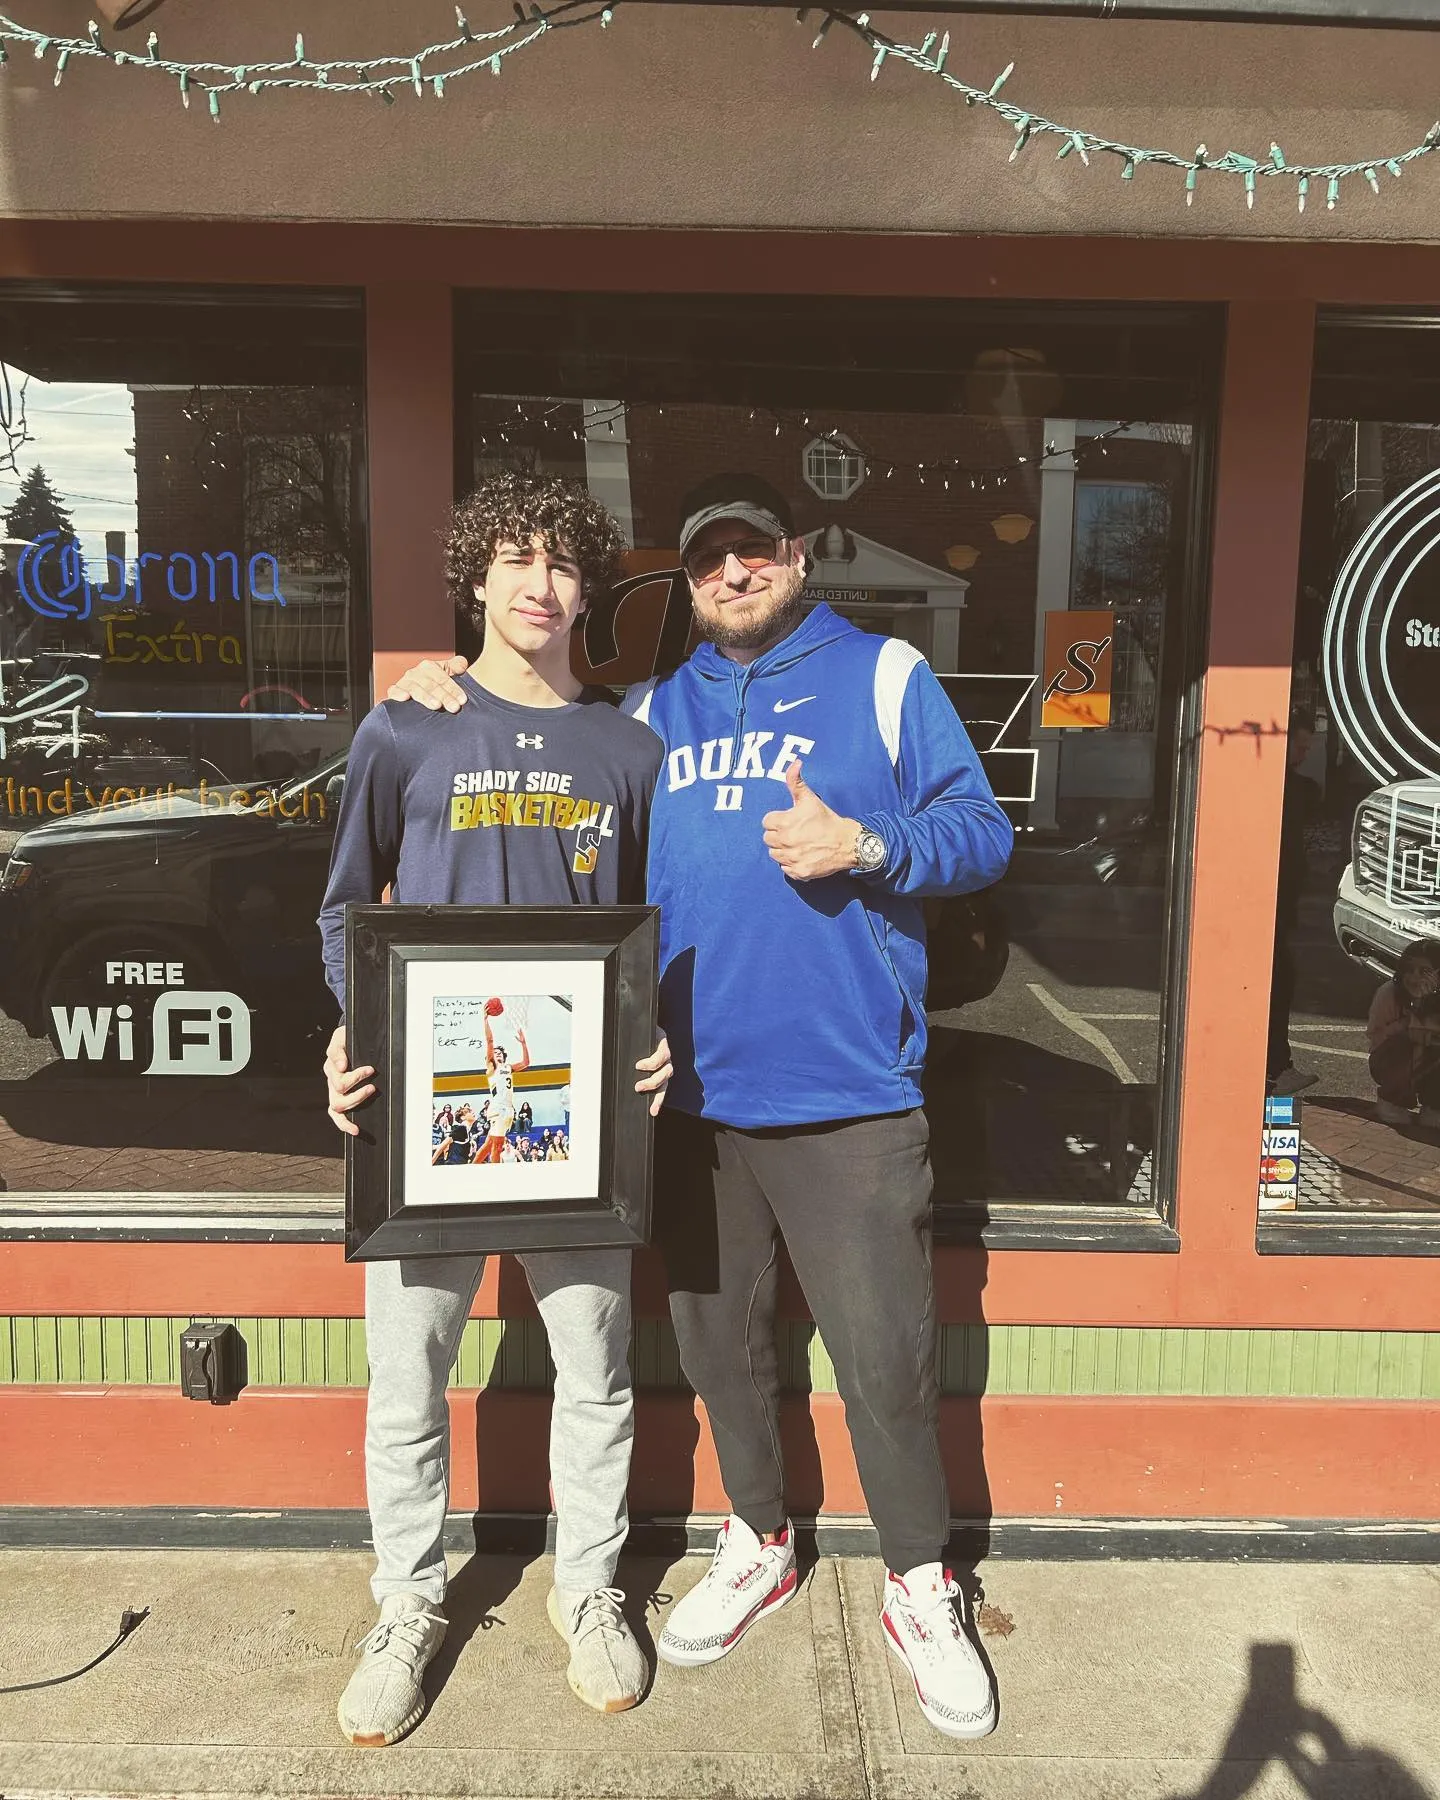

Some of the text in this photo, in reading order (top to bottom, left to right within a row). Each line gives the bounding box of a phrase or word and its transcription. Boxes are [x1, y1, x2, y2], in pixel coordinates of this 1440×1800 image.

[17, 529, 288, 620] Corona
[99, 612, 243, 664] Extra
[453, 769, 573, 795] SHADY SIDE
[667, 731, 816, 792] DUKE
[84, 782, 194, 818] your
[200, 778, 327, 819] beach
[450, 791, 614, 838] BASKETBALL
[106, 961, 185, 985] FREE
[1262, 1136, 1297, 1149] VISA
